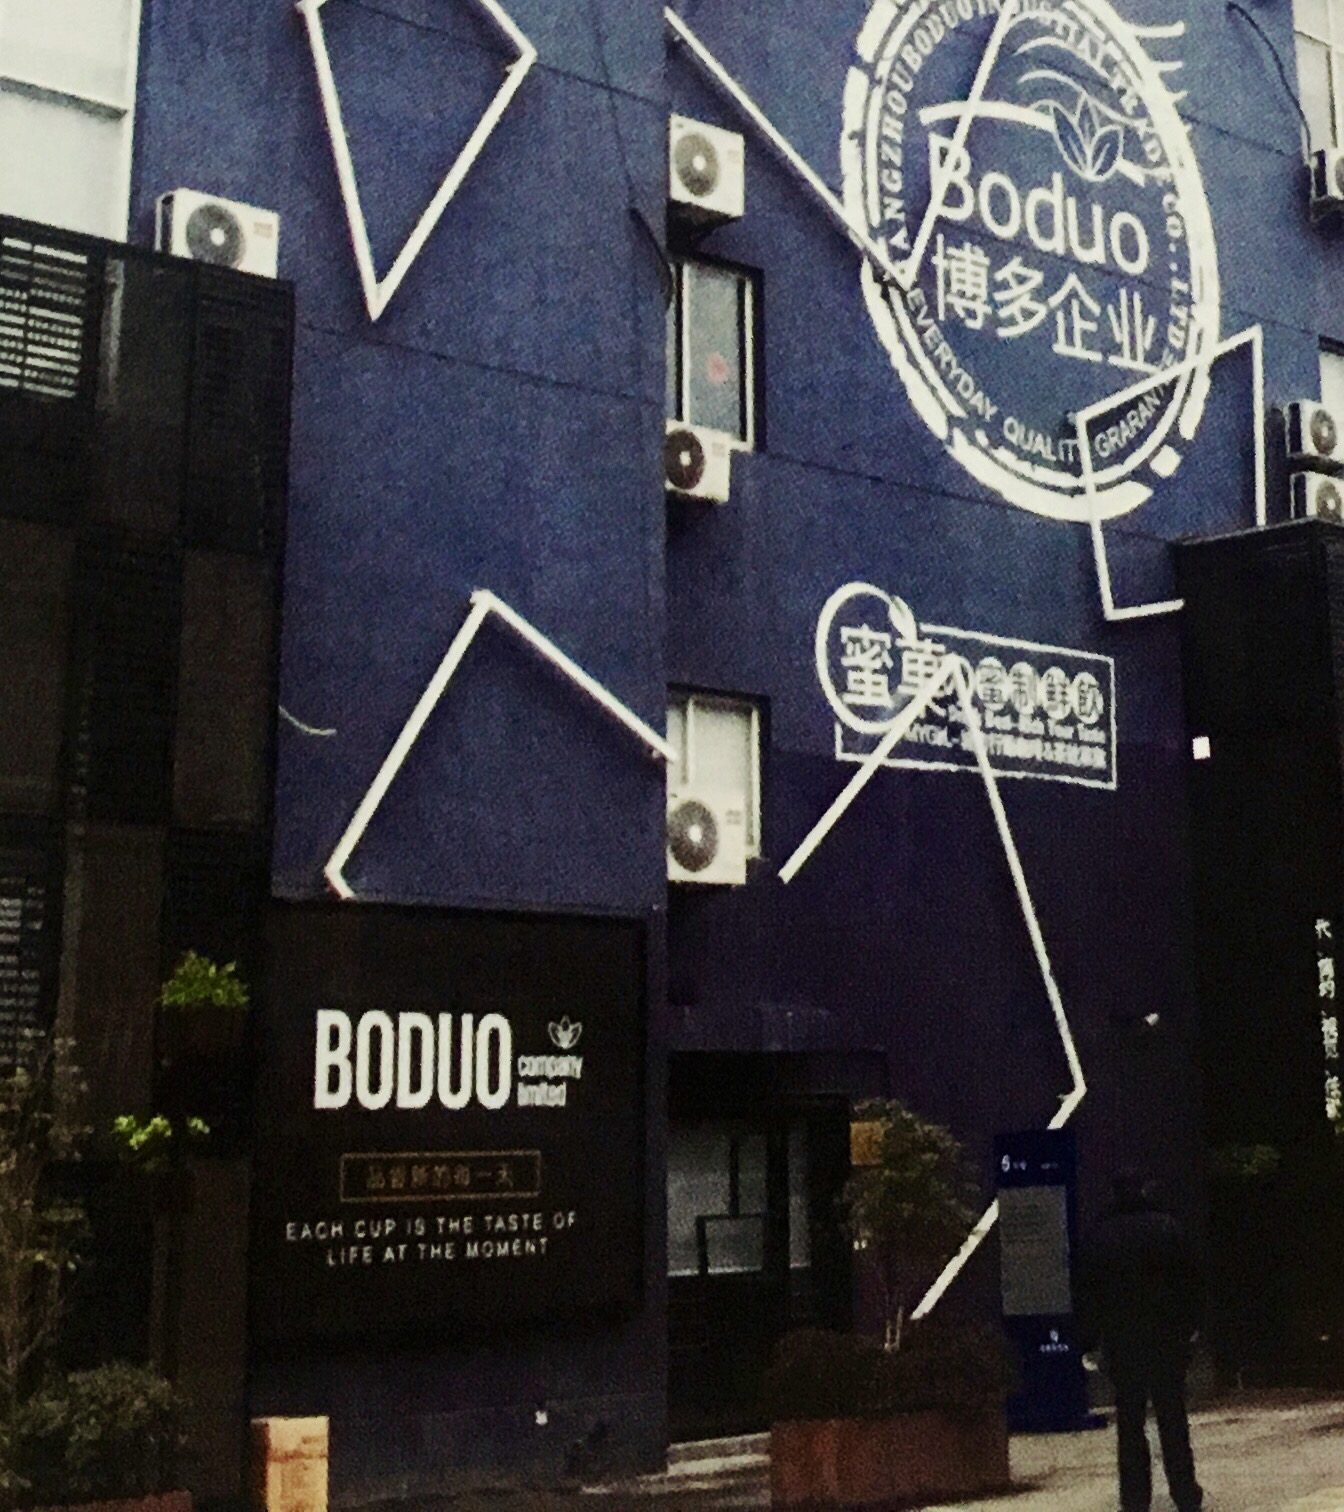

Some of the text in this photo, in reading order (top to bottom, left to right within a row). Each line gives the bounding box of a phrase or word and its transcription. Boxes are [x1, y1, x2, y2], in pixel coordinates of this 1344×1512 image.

[928, 131, 1150, 275] Boduo
[906, 286, 998, 421] EVERYDAY
[932, 233, 1160, 374] 博多企业
[314, 1008, 512, 1110] BODUO
[284, 1210, 577, 1242] EACH CUP IS THE TASTE OF
[326, 1237, 549, 1267] LIFE AT THE MOMENT
